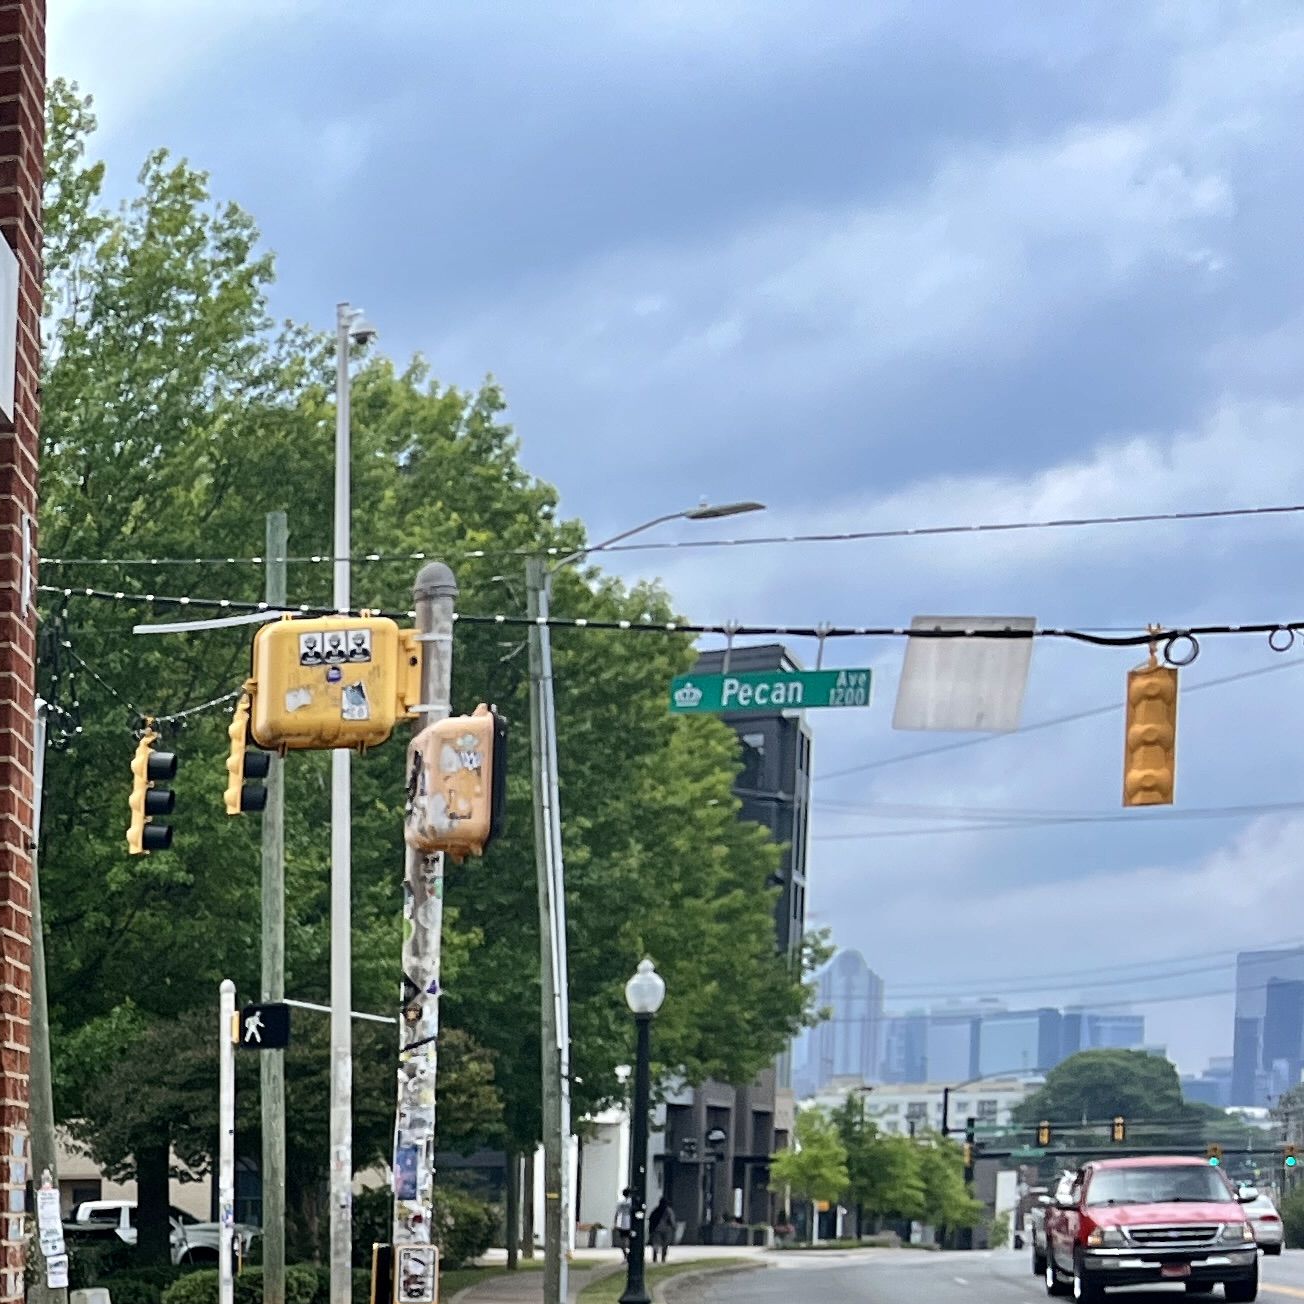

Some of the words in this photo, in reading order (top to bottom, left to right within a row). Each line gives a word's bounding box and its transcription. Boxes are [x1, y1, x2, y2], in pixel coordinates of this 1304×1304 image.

[721, 677, 804, 707] Pecan
[836, 671, 867, 688] Ave
[829, 688, 865, 706] 1200
